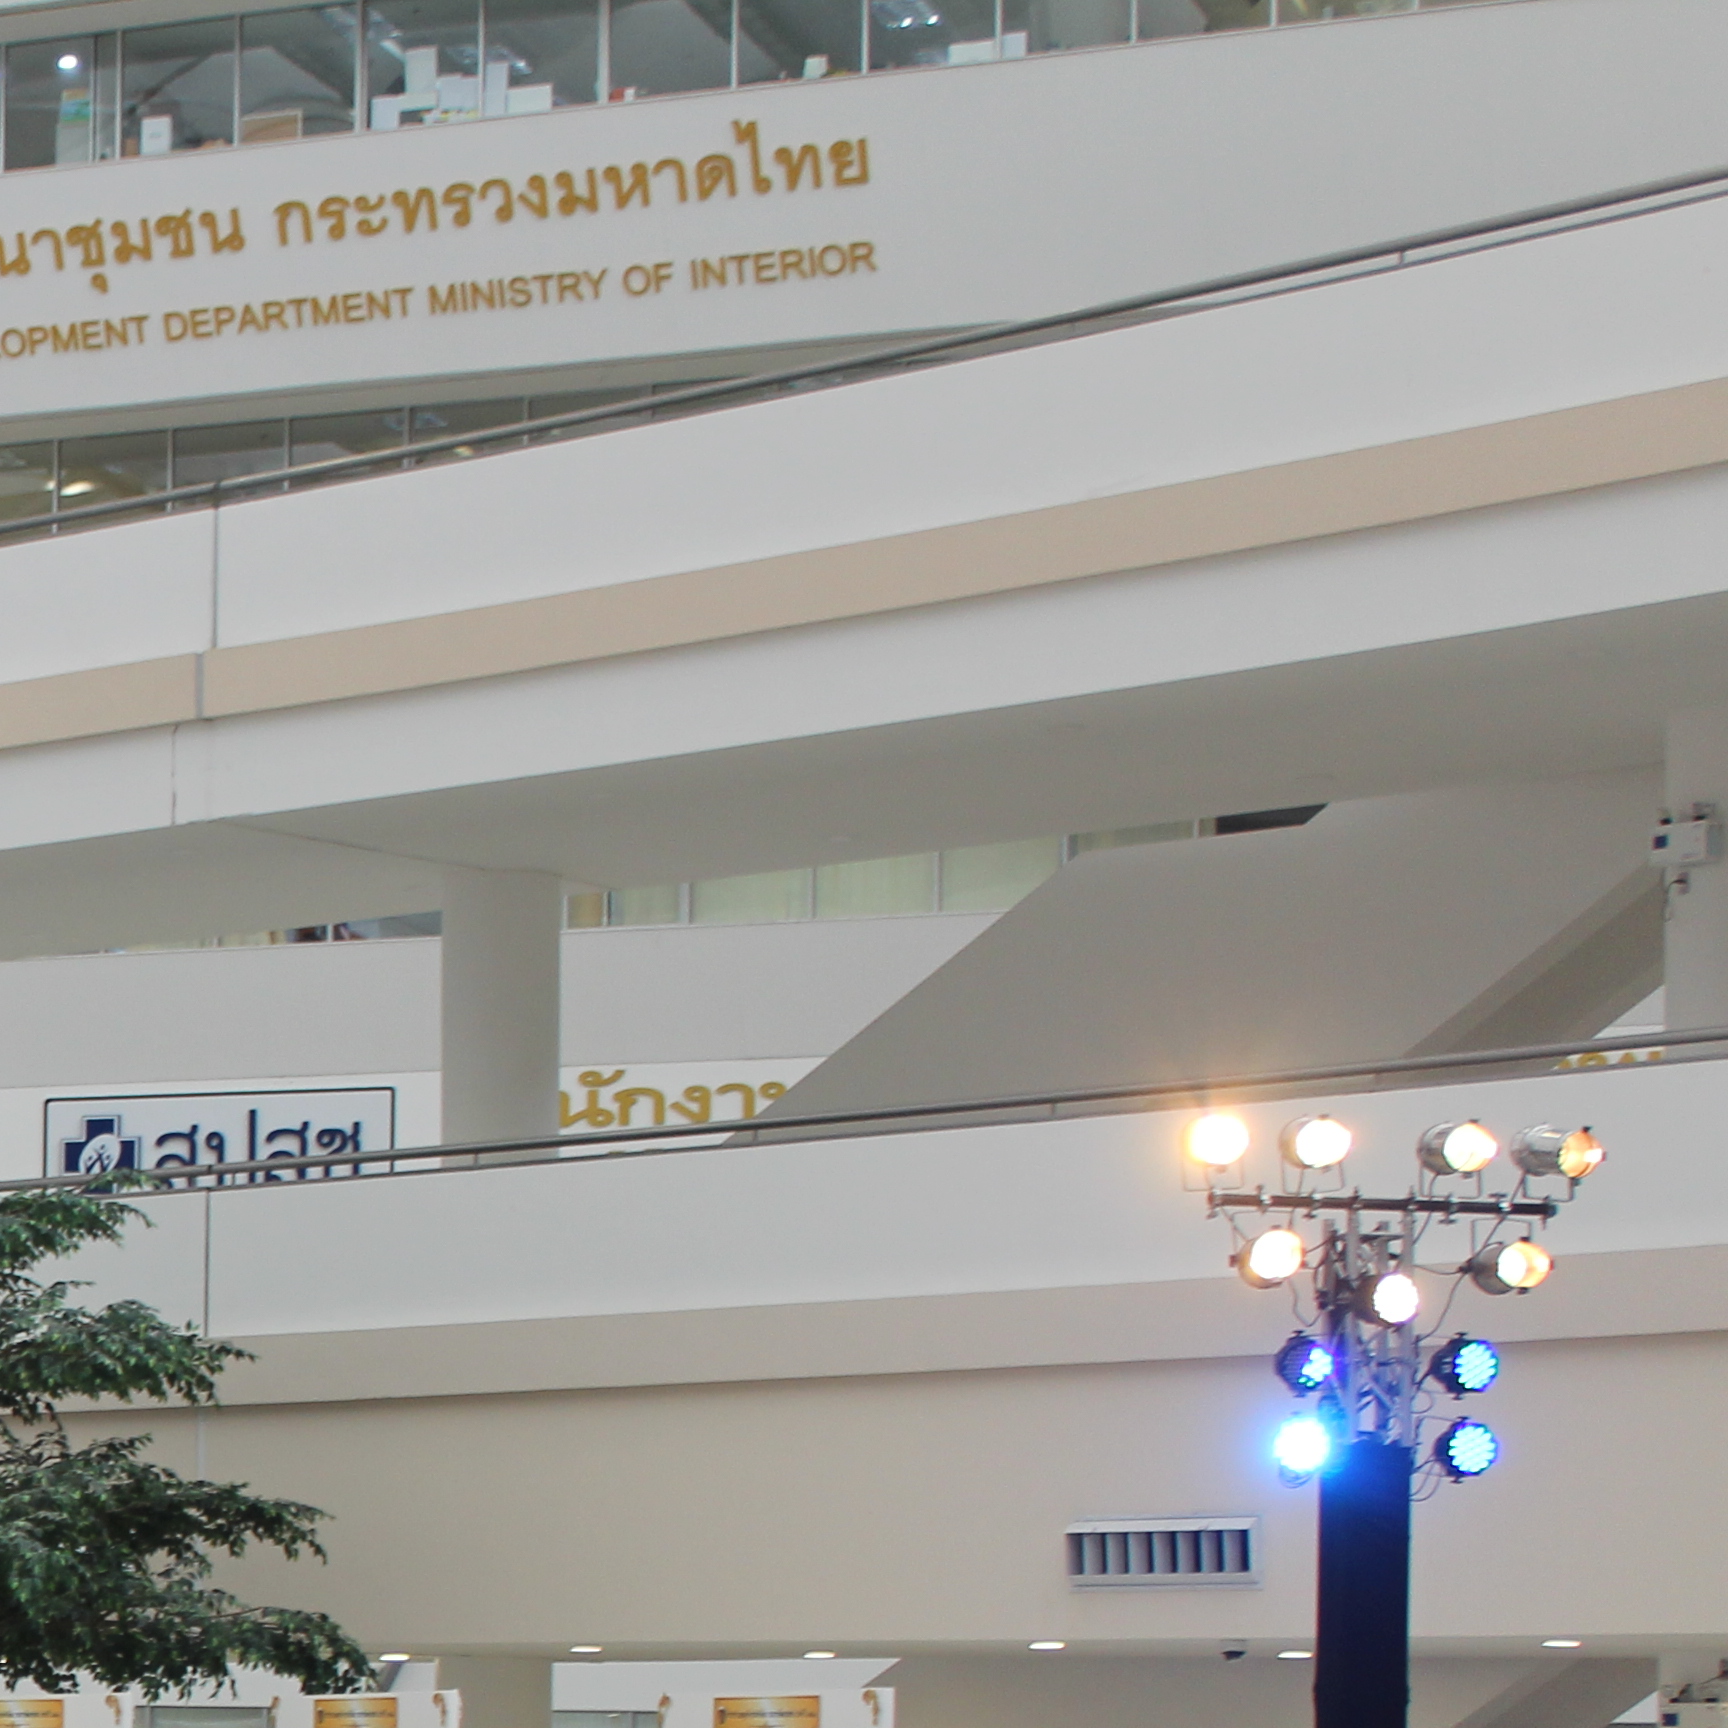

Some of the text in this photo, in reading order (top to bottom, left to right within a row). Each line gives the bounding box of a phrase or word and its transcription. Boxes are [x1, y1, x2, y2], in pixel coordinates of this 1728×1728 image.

[274, 119, 870, 246] กระทรวงมหาดไทย
[163, 286, 414, 343] DEPARTMENT
[427, 267, 608, 315] MINISTRY
[622, 261, 674, 297] OF
[691, 240, 877, 291] INTERIOR
[153, 1108, 362, 1191] สปสช
